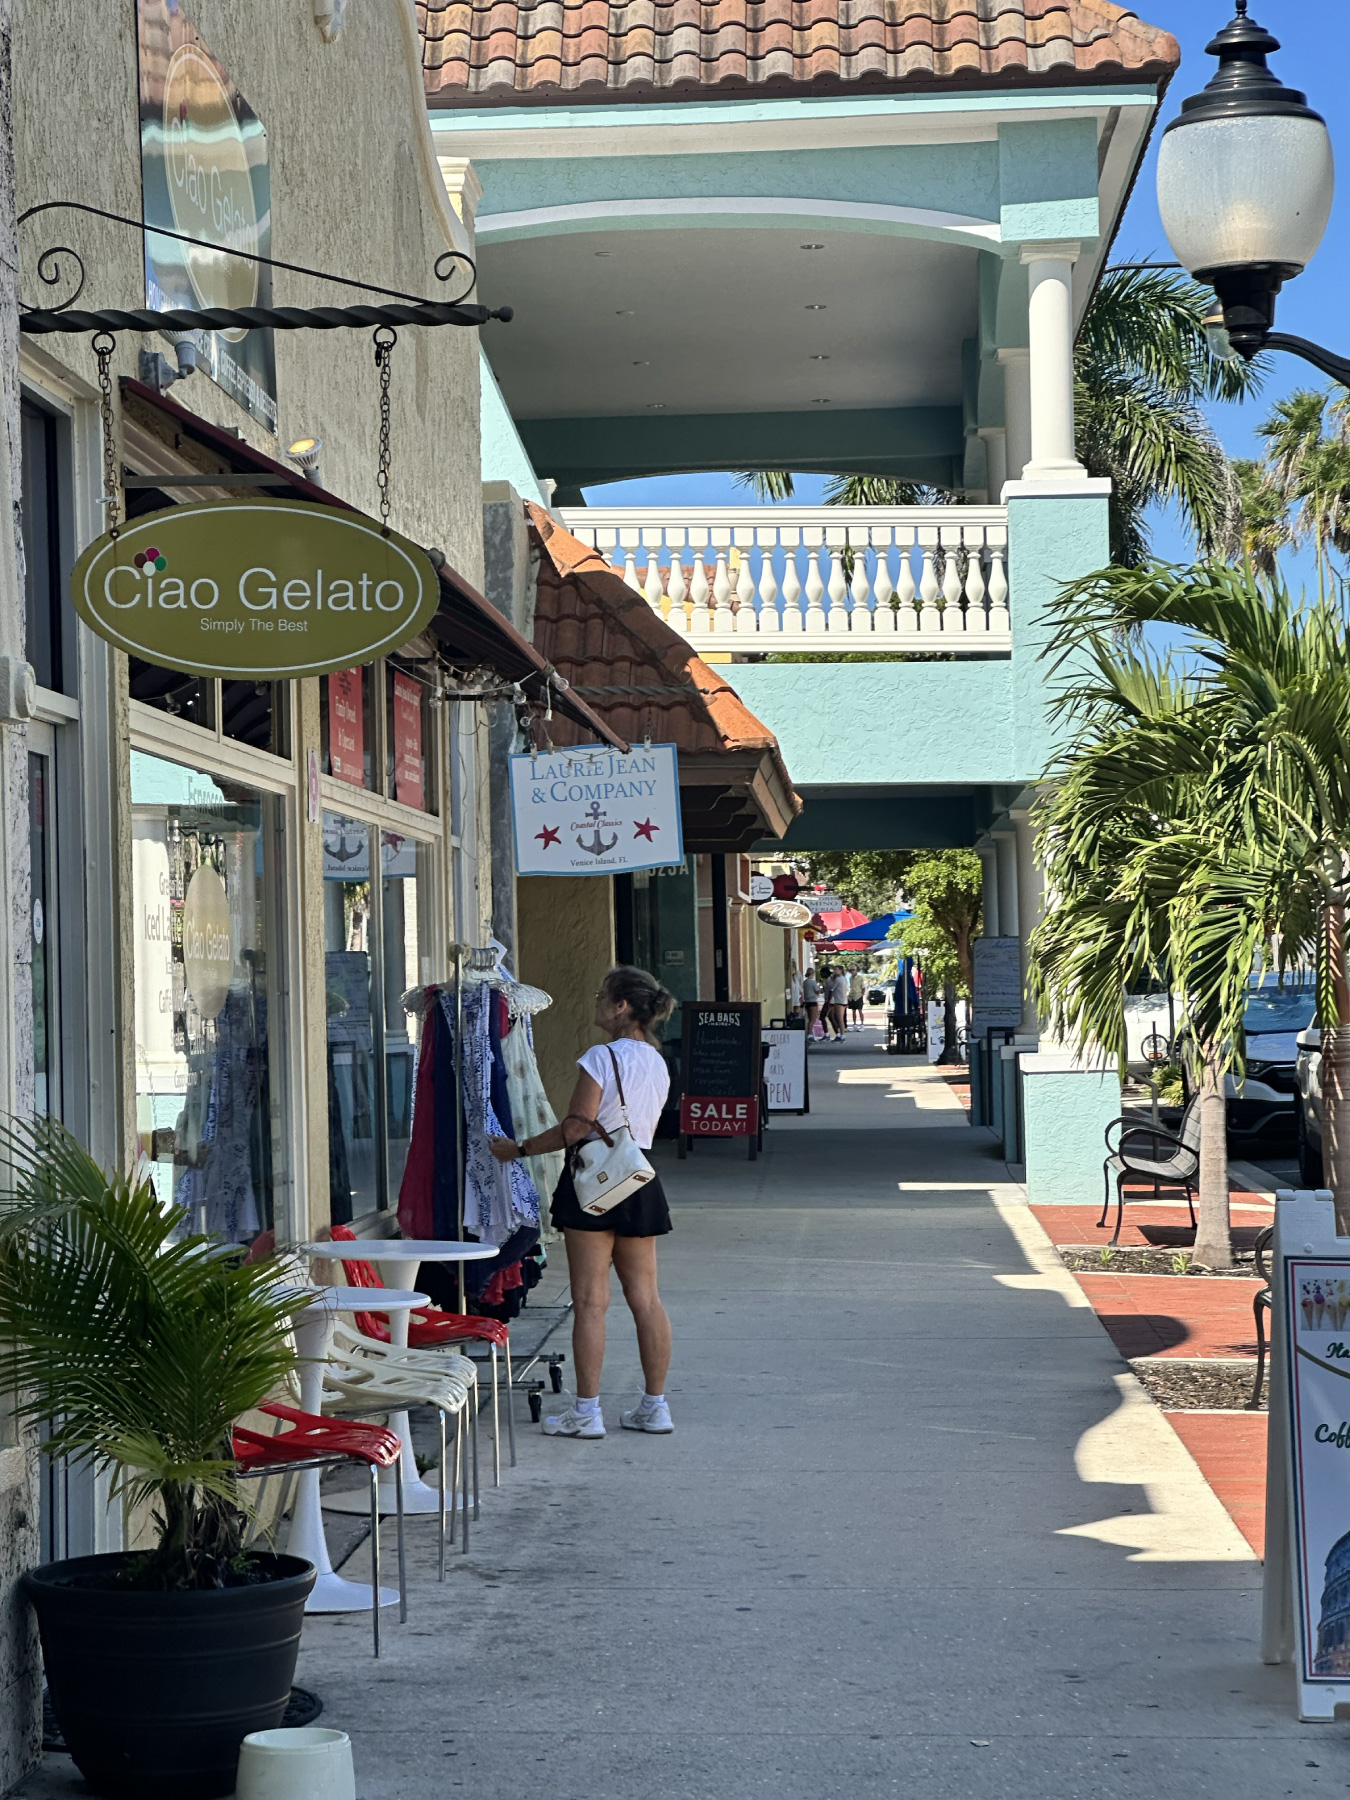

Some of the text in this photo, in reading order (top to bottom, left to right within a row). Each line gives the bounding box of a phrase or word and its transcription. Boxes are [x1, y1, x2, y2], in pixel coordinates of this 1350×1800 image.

[104, 564, 404, 612] Ciao Gelato
[200, 617, 308, 635] Simply The Best
[607, 754, 656, 778] JEAN
[531, 779, 657, 804] & COMPANY
[570, 818, 623, 832] Coastal Classics
[570, 859, 593, 867] Venice
[619, 856, 628, 864] FL
[768, 903, 801, 918] Posh
[186, 919, 230, 962] Ciao Gelato
[699, 1012, 741, 1027] SEA BAGS
[769, 1083, 792, 1103] PEN
[690, 1102, 748, 1119] SALE
[691, 1120, 746, 1132] TODAY!
[1325, 1341, 1350, 1359] Ita
[1315, 1421, 1350, 1448] Coff
